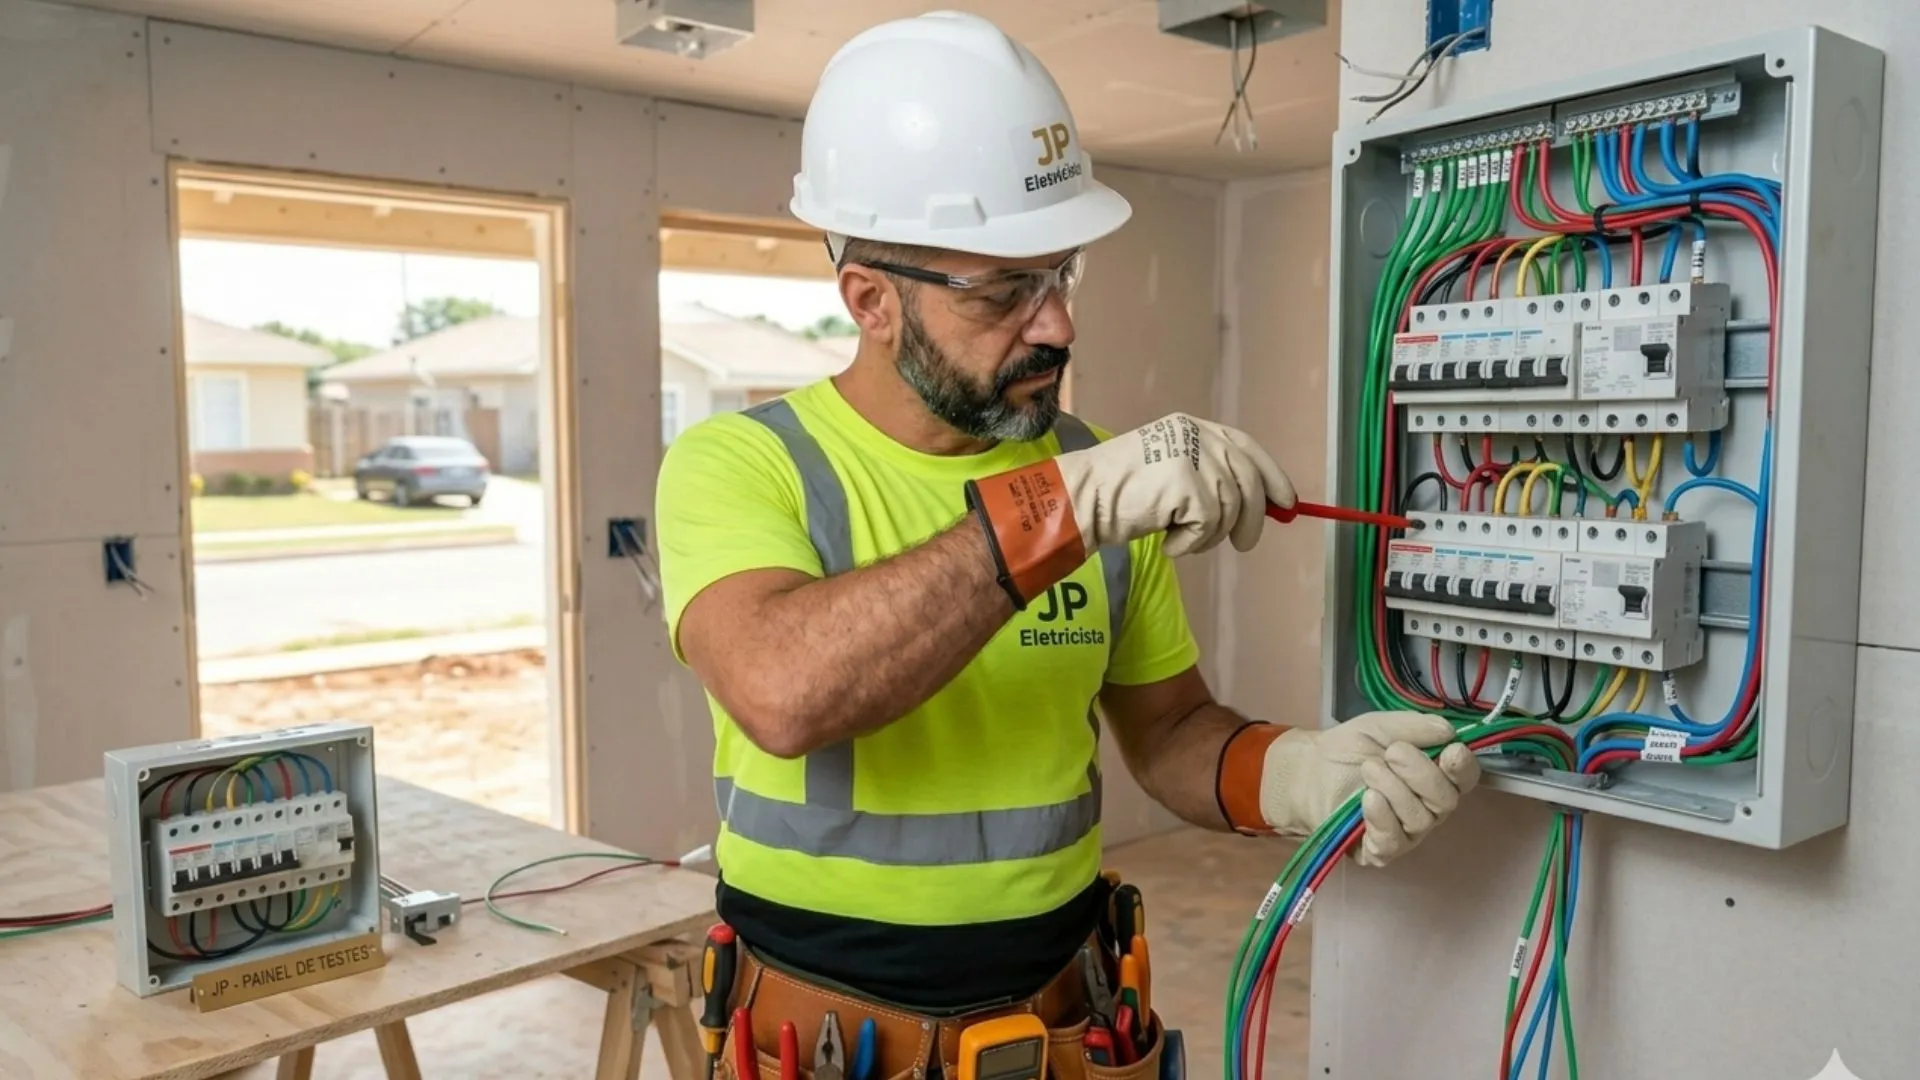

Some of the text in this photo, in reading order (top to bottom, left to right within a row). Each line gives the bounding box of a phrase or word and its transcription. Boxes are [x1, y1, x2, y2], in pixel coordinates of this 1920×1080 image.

[1032, 123, 1070, 166] JP
[1038, 582, 1088, 622] JP
[1020, 627, 1105, 646] Eletricista
[212, 979, 230, 997] JP
[242, 966, 293, 989] PAINEL
[296, 958, 315, 976] DE
[319, 944, 371, 970] TESTES
